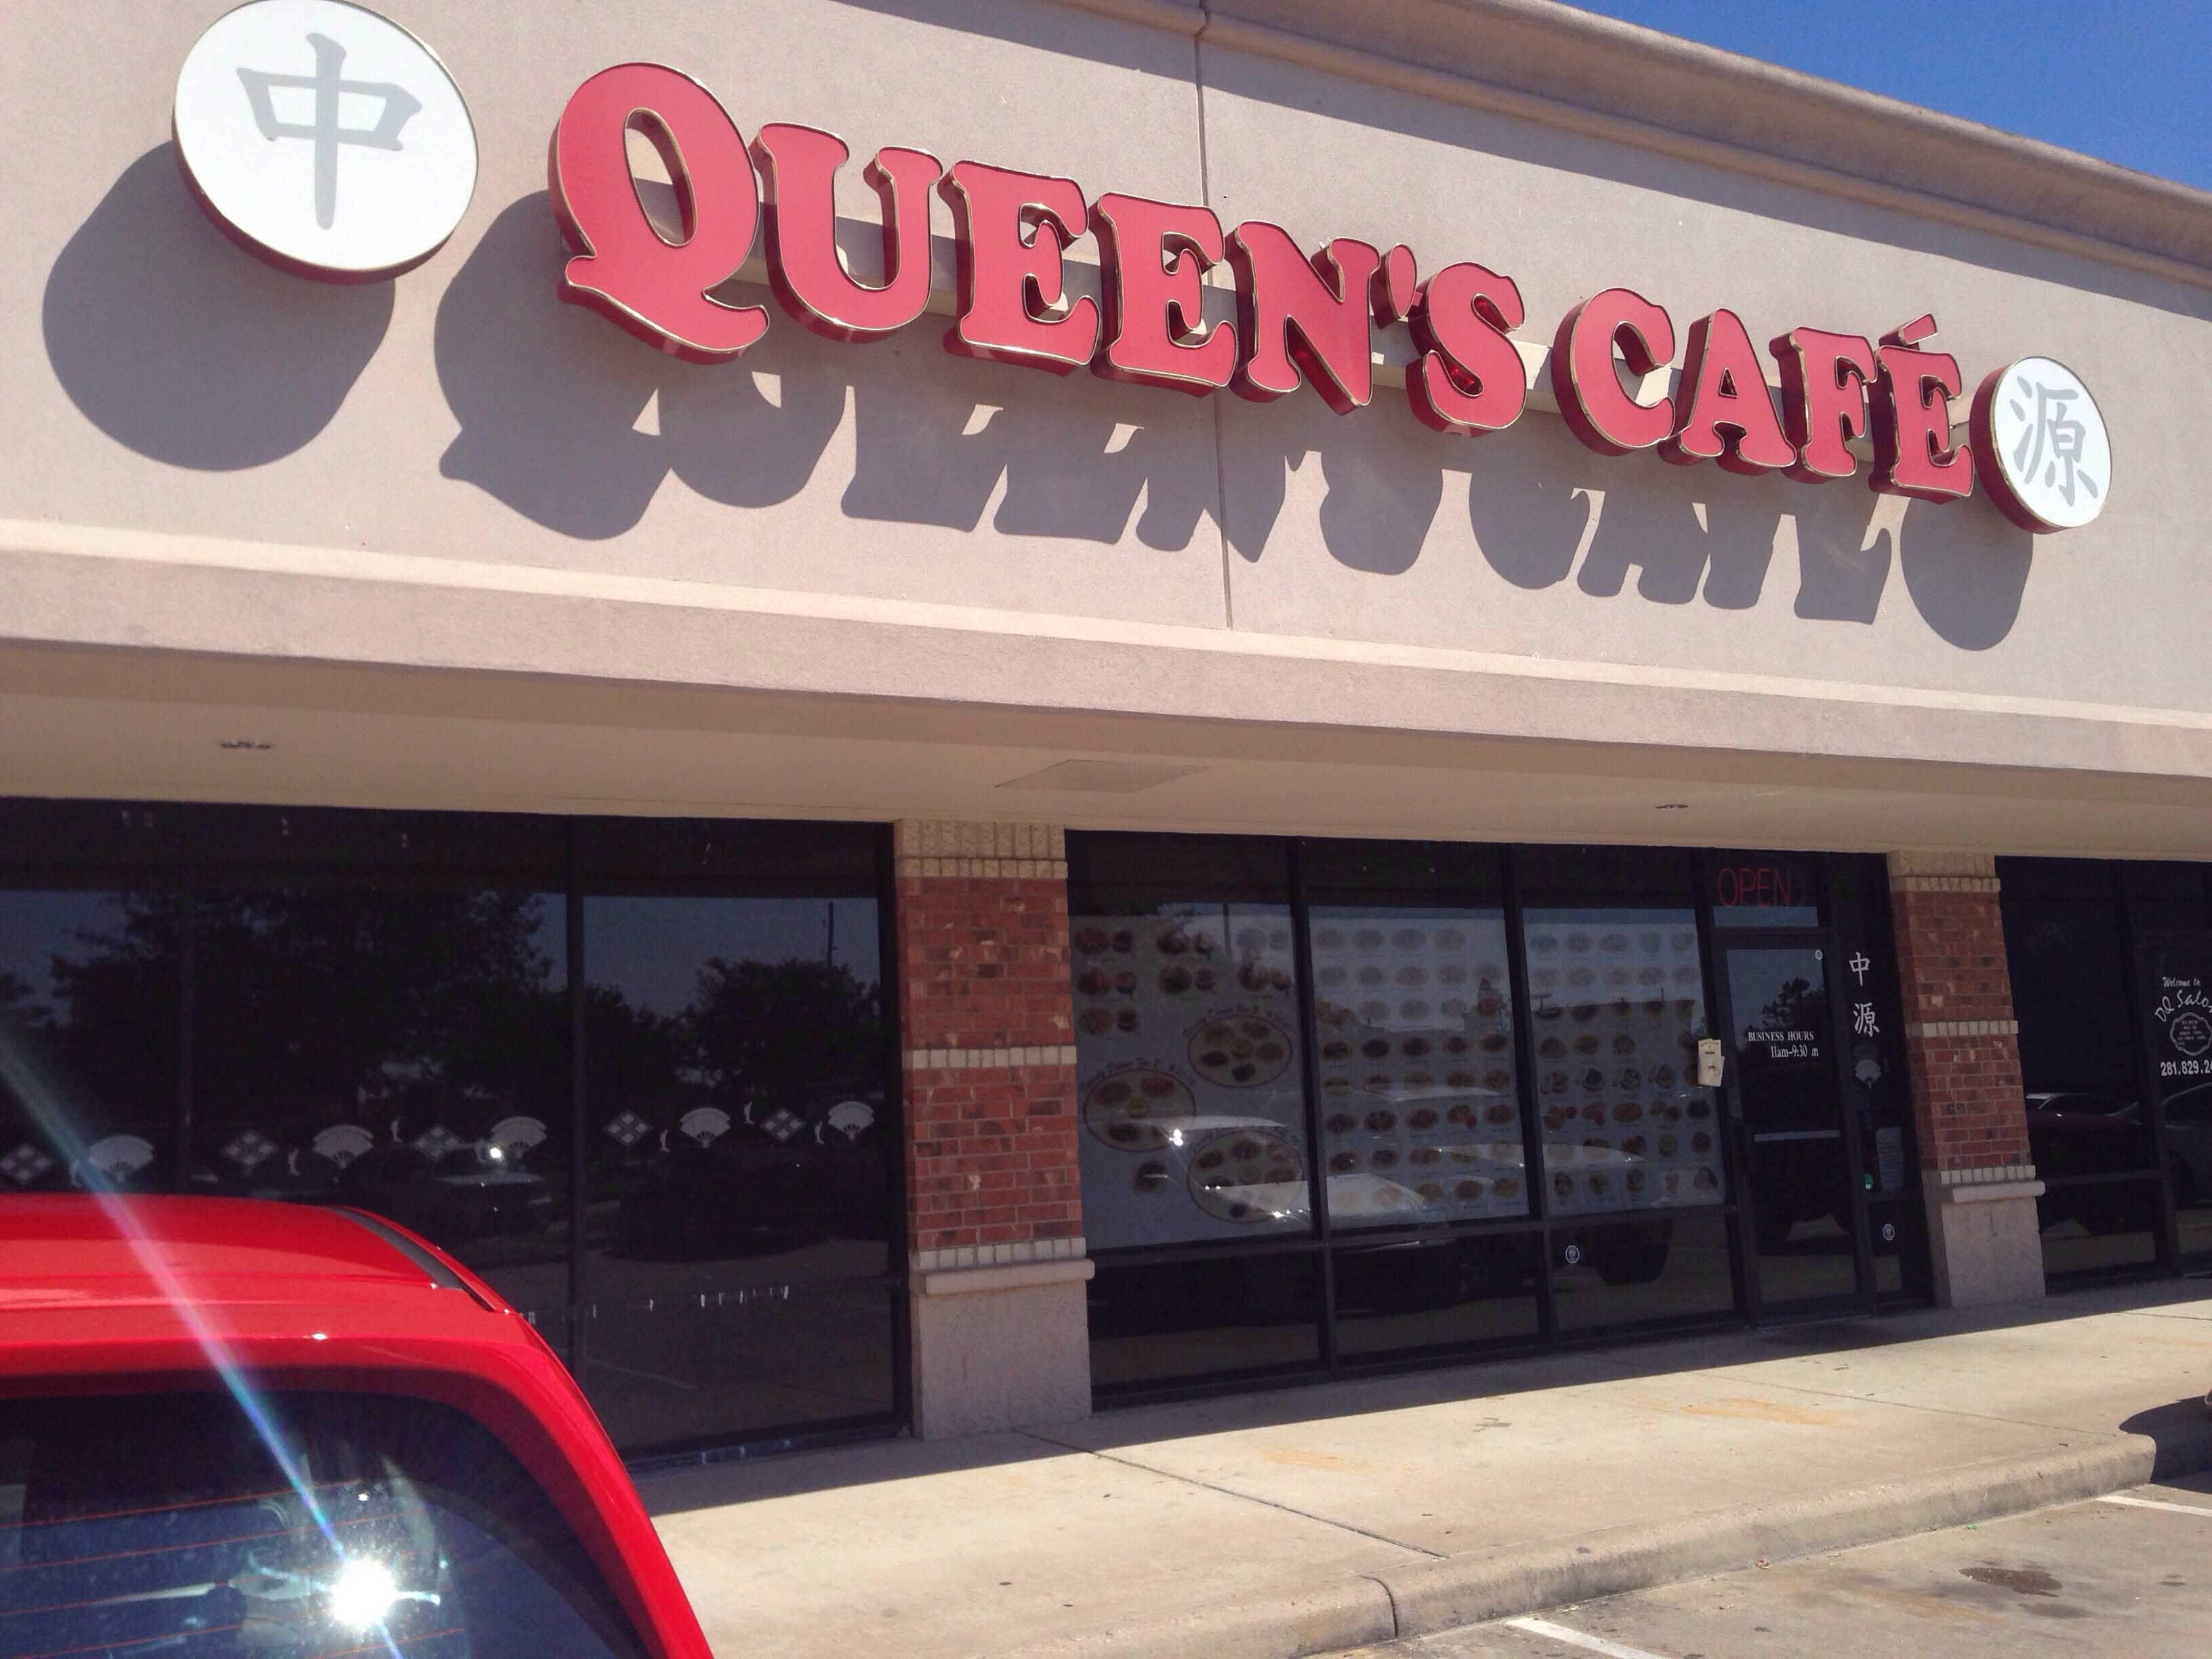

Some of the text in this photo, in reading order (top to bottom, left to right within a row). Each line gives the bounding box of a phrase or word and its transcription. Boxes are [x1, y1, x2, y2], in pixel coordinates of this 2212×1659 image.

[236, 32, 423, 230] 中
[549, 61, 1973, 501] QUEEN'S CAFÉ
[2012, 374, 2099, 507] 源
[1717, 867, 1790, 908] OPEN
[1748, 1030, 1815, 1042] BUSINESS HOURS
